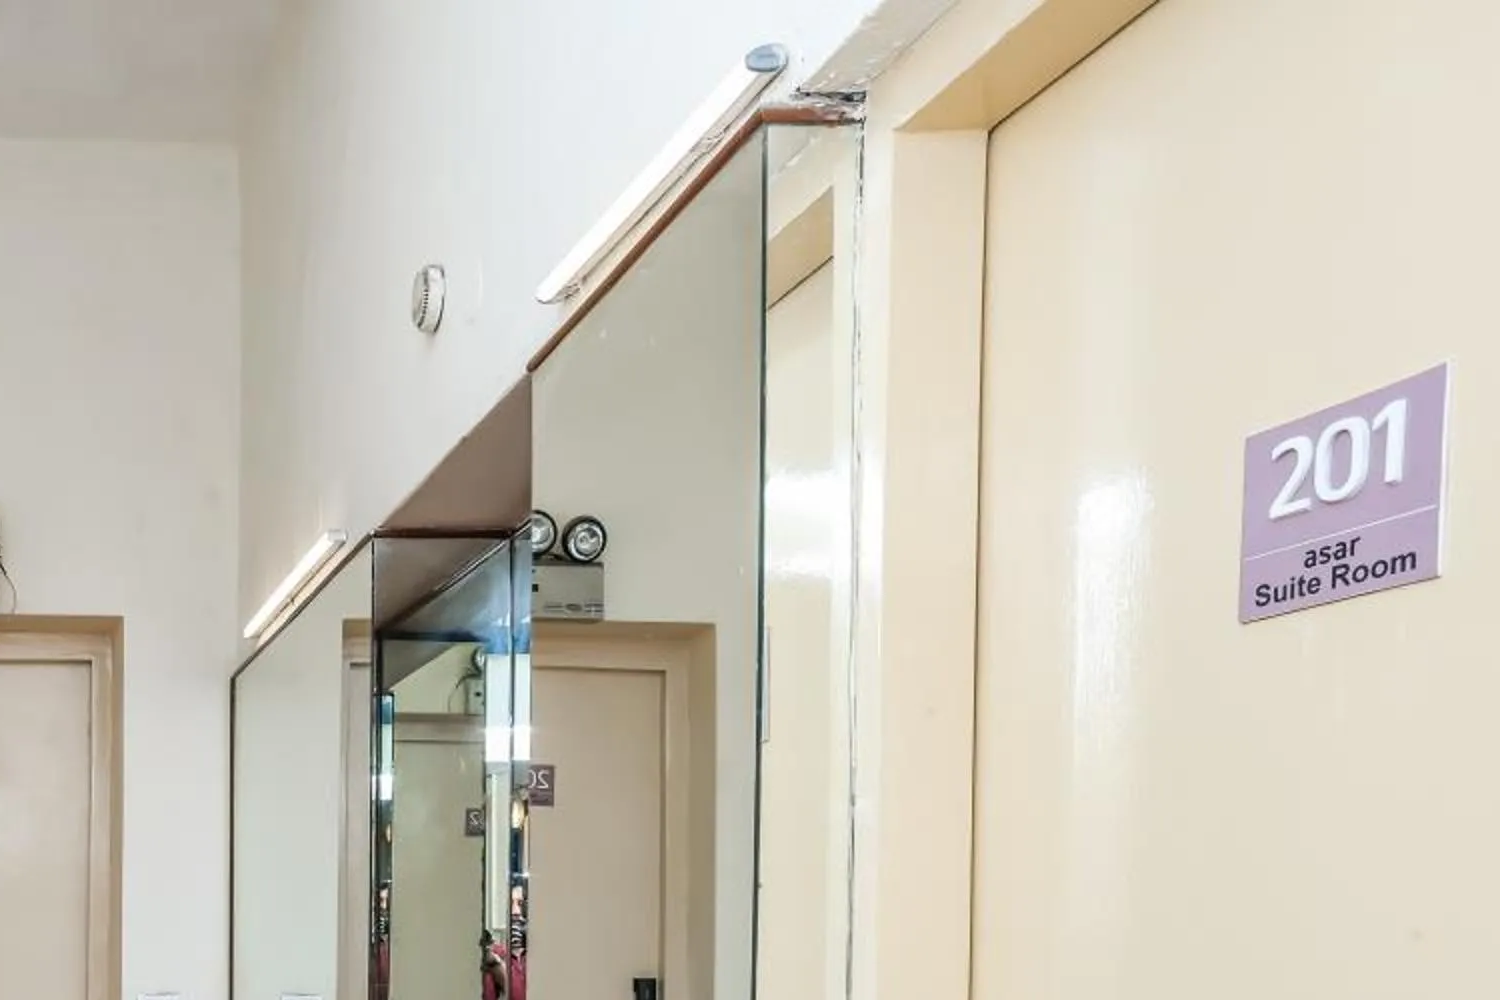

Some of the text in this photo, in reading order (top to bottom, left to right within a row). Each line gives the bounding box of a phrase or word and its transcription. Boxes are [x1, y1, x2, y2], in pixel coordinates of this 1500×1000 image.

[1269, 397, 1408, 519] 201
[1255, 551, 1417, 608] Suite Room
[1304, 536, 1361, 569] asar
